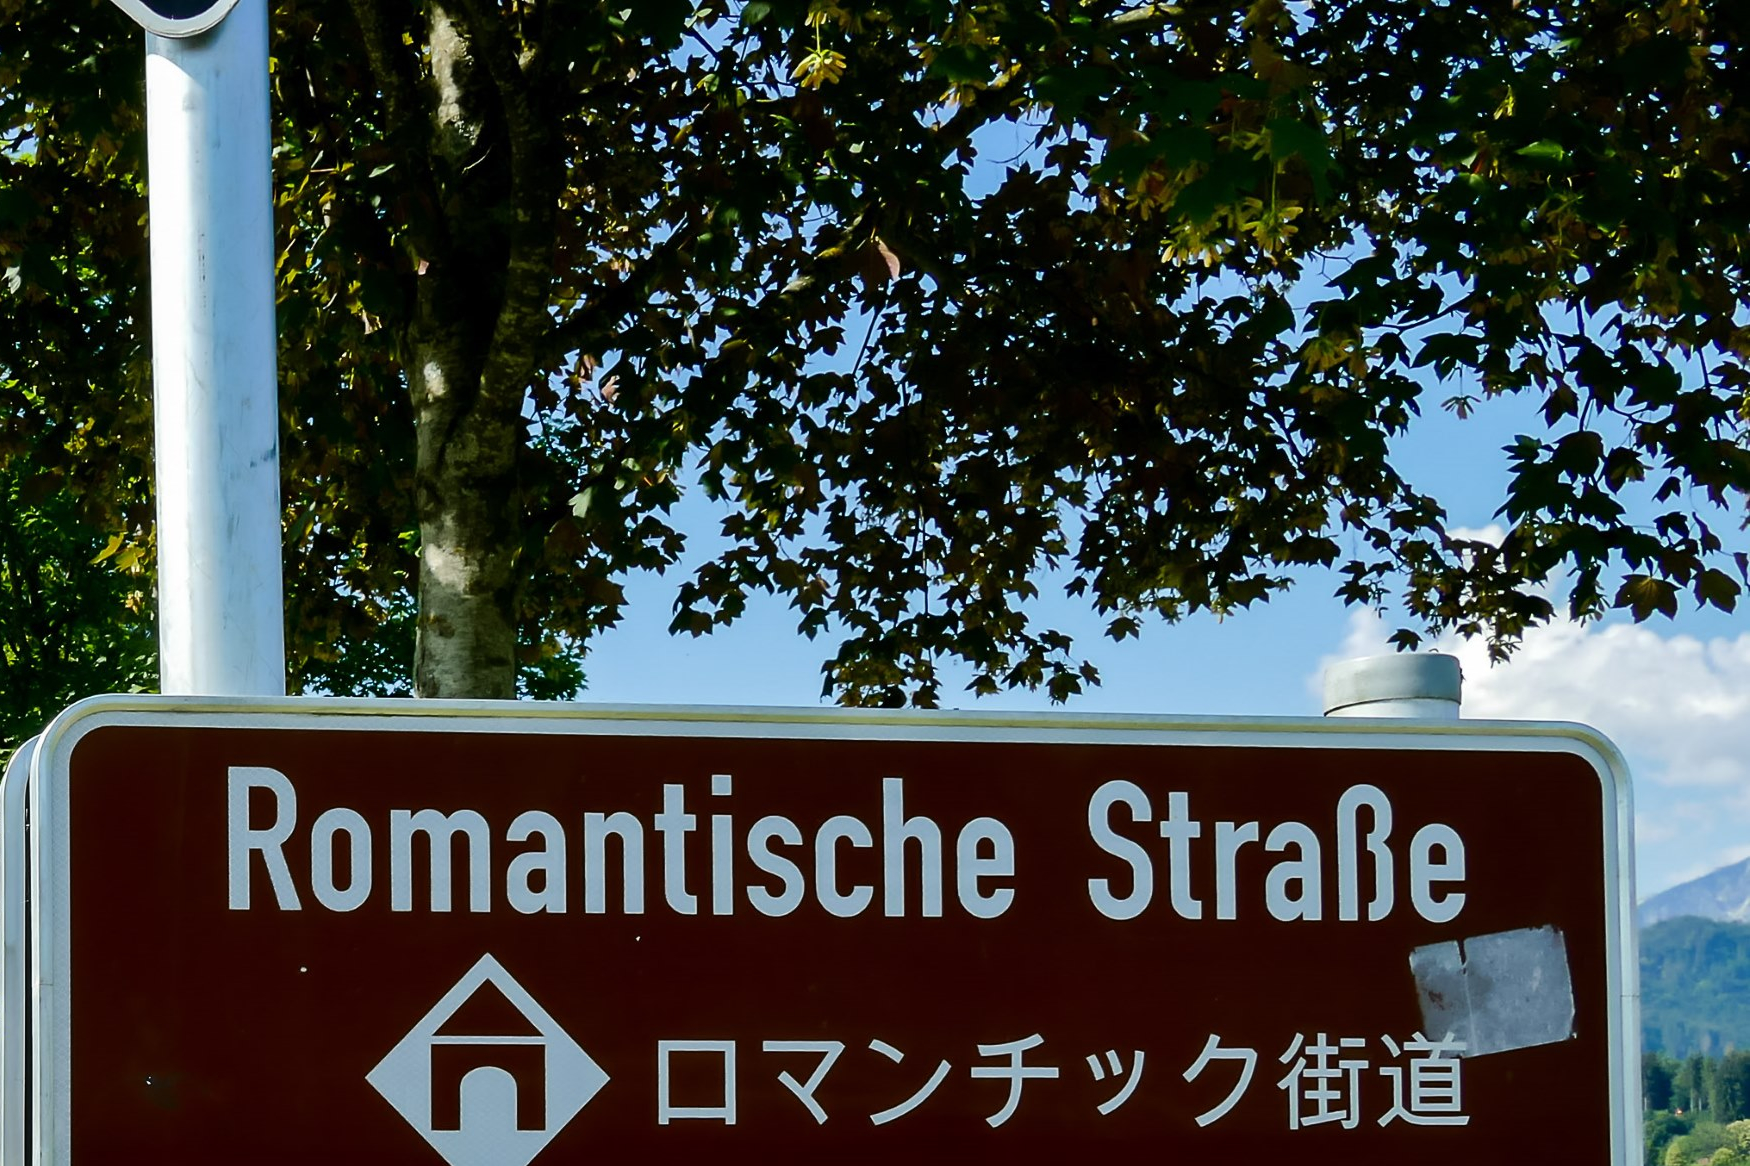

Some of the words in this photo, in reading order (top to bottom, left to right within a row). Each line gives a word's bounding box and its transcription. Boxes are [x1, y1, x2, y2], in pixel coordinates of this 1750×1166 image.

[227, 766, 1015, 919] Romantische
[1087, 779, 1466, 924] Straße
[657, 1030, 1471, 1131] ロマンチック街道
